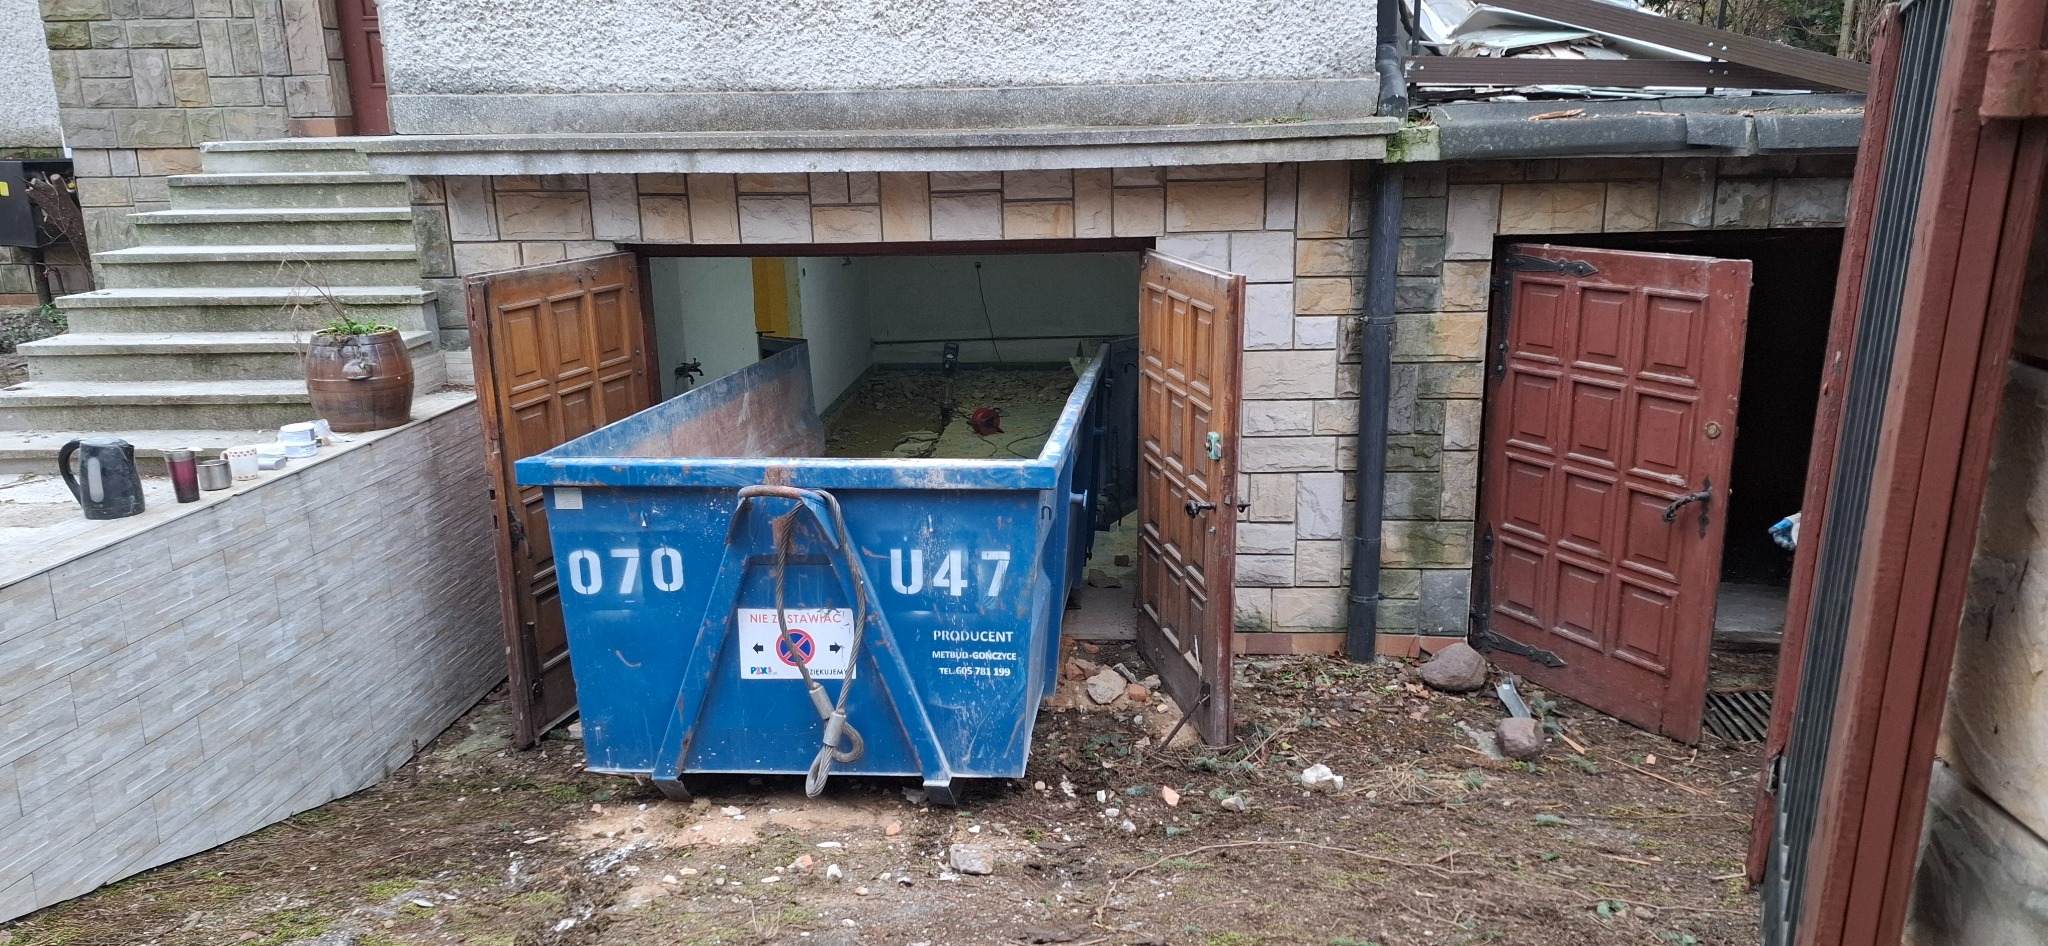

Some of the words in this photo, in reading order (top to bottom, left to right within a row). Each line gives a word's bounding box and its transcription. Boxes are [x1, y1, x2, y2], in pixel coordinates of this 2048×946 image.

[568, 547, 685, 595] 070
[889, 548, 1011, 597] U47
[750, 613, 768, 624] NIE
[772, 611, 842, 624] ZSTAWIAĆ
[933, 629, 1014, 643] PRODUCENT
[807, 668, 847, 676] ZIĘKUJEMY
[956, 666, 972, 675] 605
[975, 667, 991, 675] 781
[993, 667, 1011, 677] 199
